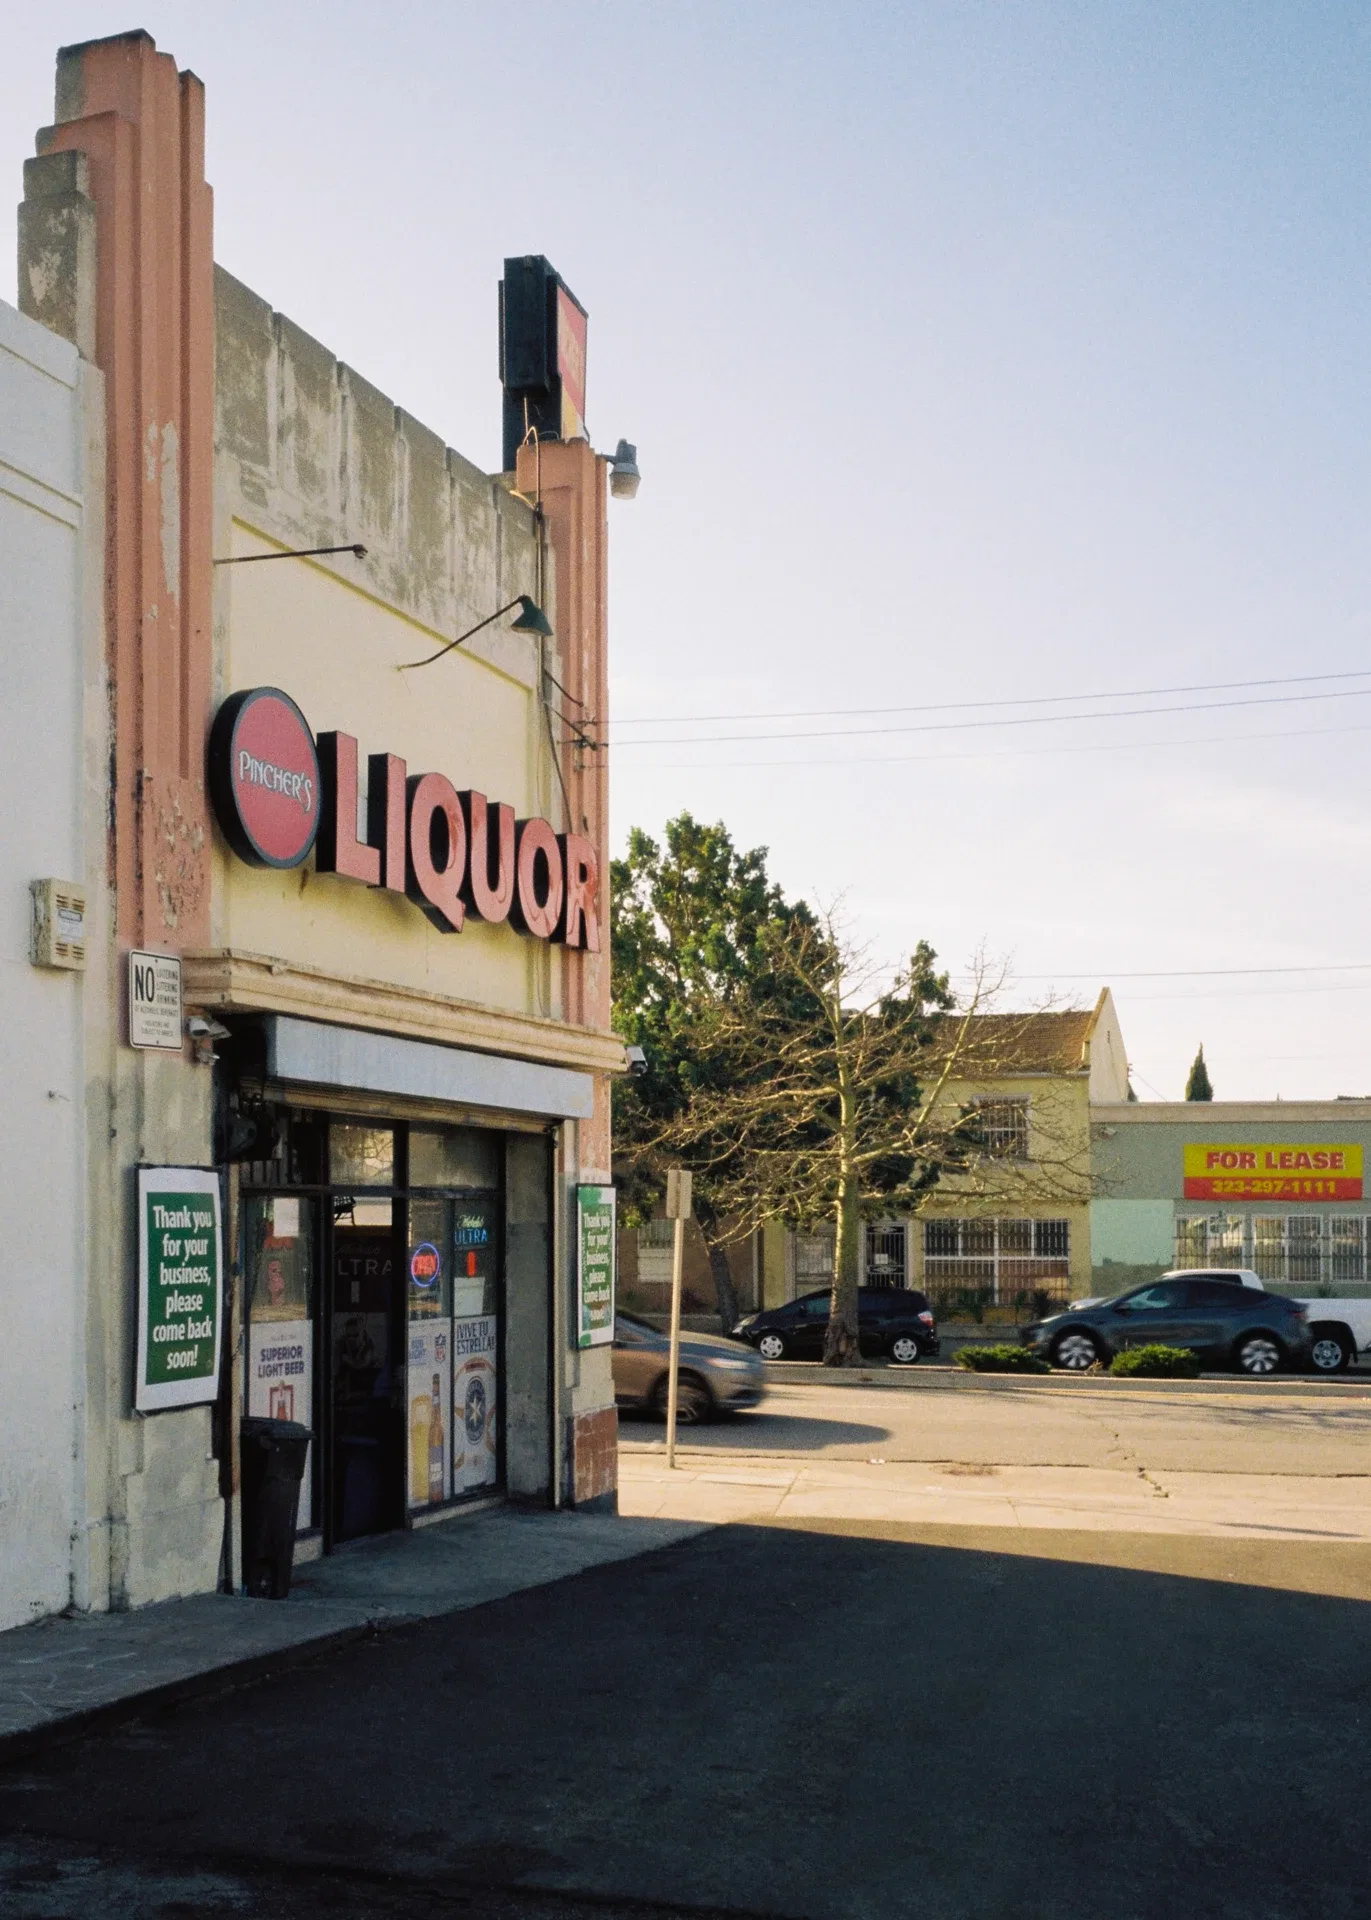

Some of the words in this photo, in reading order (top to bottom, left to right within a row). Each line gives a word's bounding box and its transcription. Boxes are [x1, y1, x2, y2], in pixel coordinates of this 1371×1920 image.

[239, 750, 312, 812] PINCHER'S
[335, 730, 601, 954] LIQUOR
[135, 964, 155, 1003] NO
[1206, 1151, 1257, 1169] FOR
[1264, 1151, 1346, 1170] LEASE
[1212, 1179, 1336, 1194] 323-297-1111
[152, 1205, 192, 1229] Thank
[193, 1211, 213, 1234] you
[162, 1233, 182, 1257] for
[184, 1238, 209, 1261] your
[454, 1228, 488, 1246] ULTRA
[159, 1261, 212, 1287] business,
[337, 1259, 393, 1276] LTRA
[165, 1290, 203, 1319] please
[152, 1325, 186, 1343] come
[187, 1316, 213, 1339] back
[478, 1321, 490, 1336] TU
[166, 1344, 198, 1370] soon!
[260, 1345, 303, 1362] SUPERIOR
[258, 1362, 285, 1379] LIGHT
[284, 1361, 305, 1376] BEER
